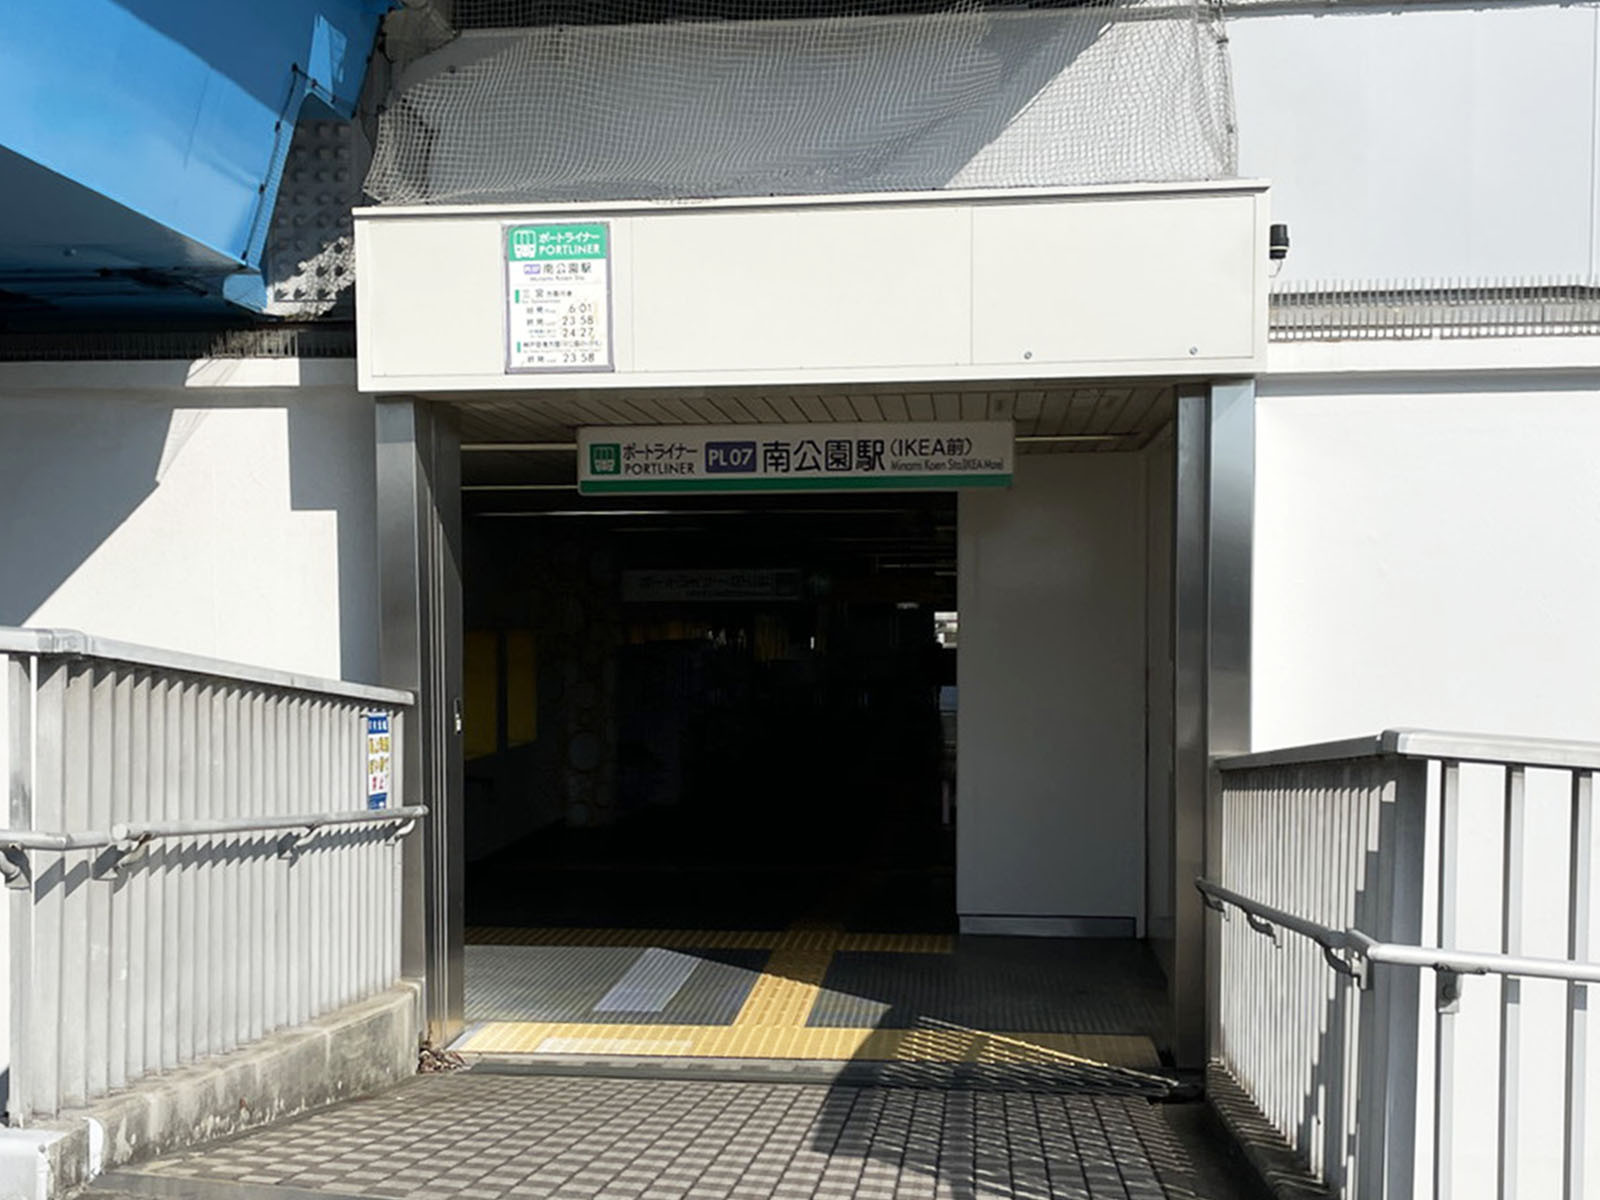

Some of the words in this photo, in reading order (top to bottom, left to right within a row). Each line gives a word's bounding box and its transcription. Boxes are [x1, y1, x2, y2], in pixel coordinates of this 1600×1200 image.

[538, 231, 600, 244] ポートライナー
[538, 243, 600, 256] PORTLINER
[623, 442, 698, 461] ポートライナー
[708, 448, 754, 467] PL07
[762, 439, 885, 474] 南公園駅
[624, 462, 695, 476] PORTLINER
[924, 459, 947, 471] Koen
